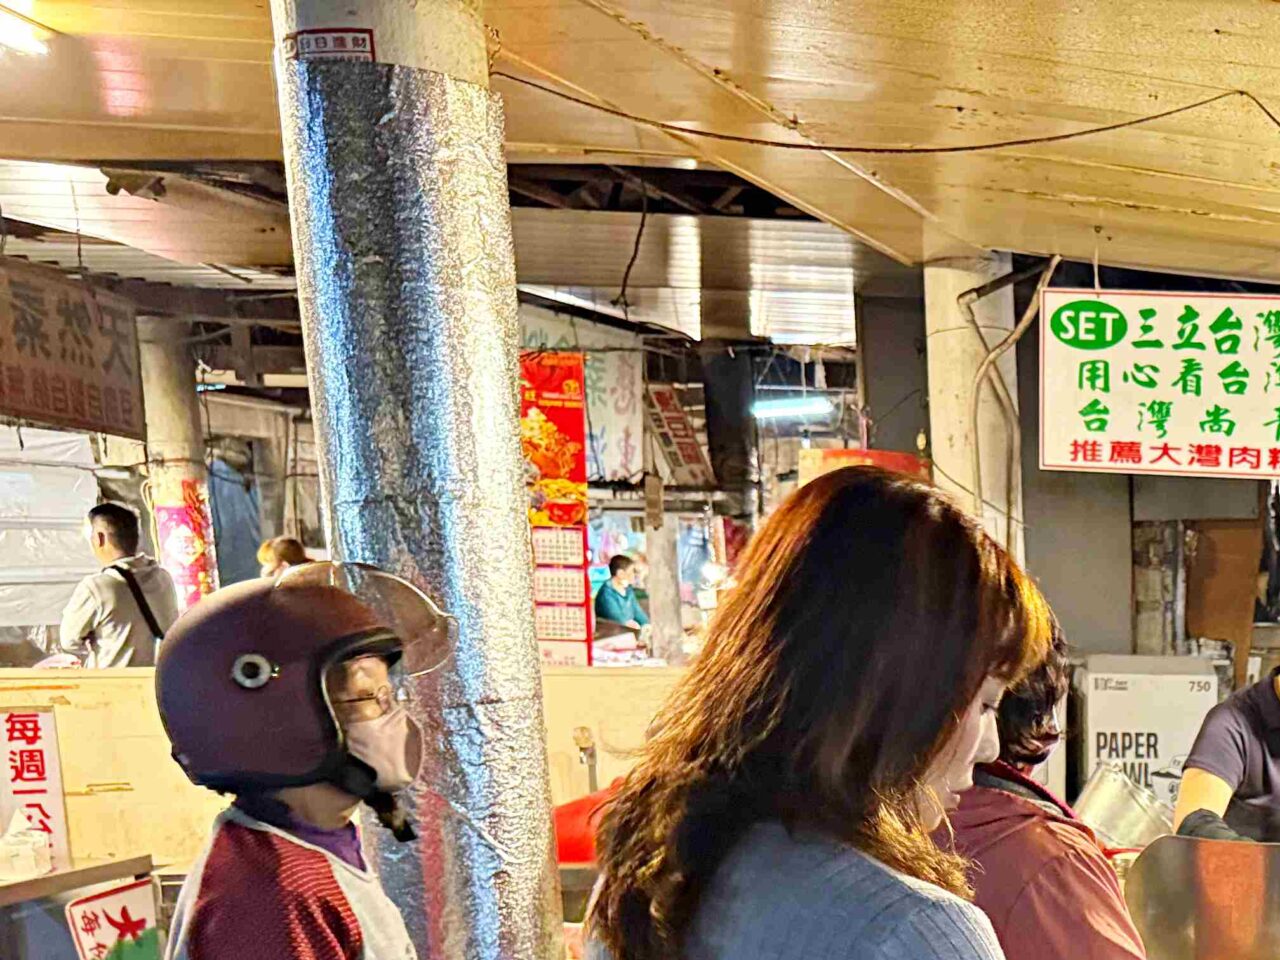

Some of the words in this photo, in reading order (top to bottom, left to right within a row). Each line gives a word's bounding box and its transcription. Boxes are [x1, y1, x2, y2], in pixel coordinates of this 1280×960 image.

[1060, 310, 1120, 341] SET
[1188, 681, 1211, 693] 750
[1095, 731, 1159, 759] PAPER
[1096, 762, 1153, 788] WL
[5, 712, 54, 872] 每週一公
